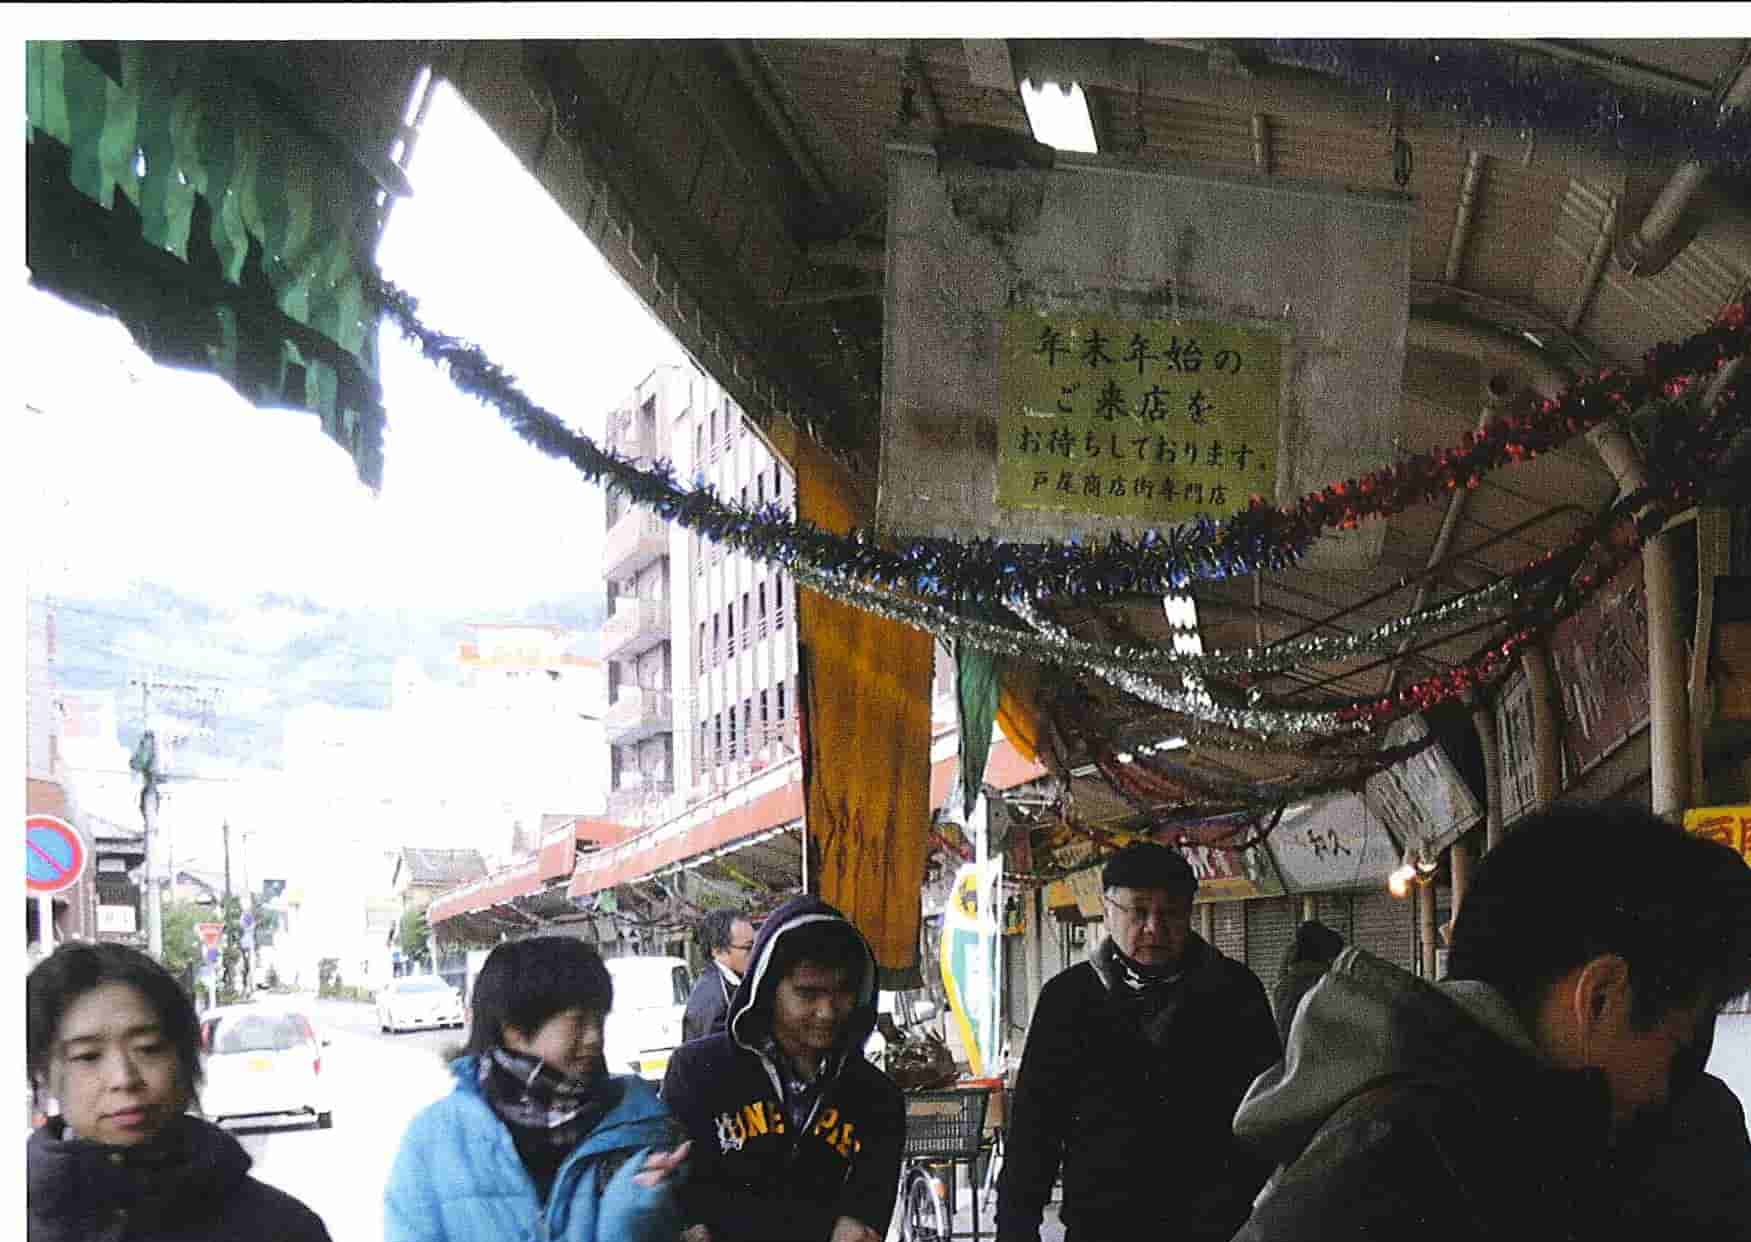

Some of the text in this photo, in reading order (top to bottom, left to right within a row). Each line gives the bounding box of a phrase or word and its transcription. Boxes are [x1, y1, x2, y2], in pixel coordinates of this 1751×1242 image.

[1033, 326, 1242, 375] 年末年始の
[1056, 382, 1215, 427] ご来店を
